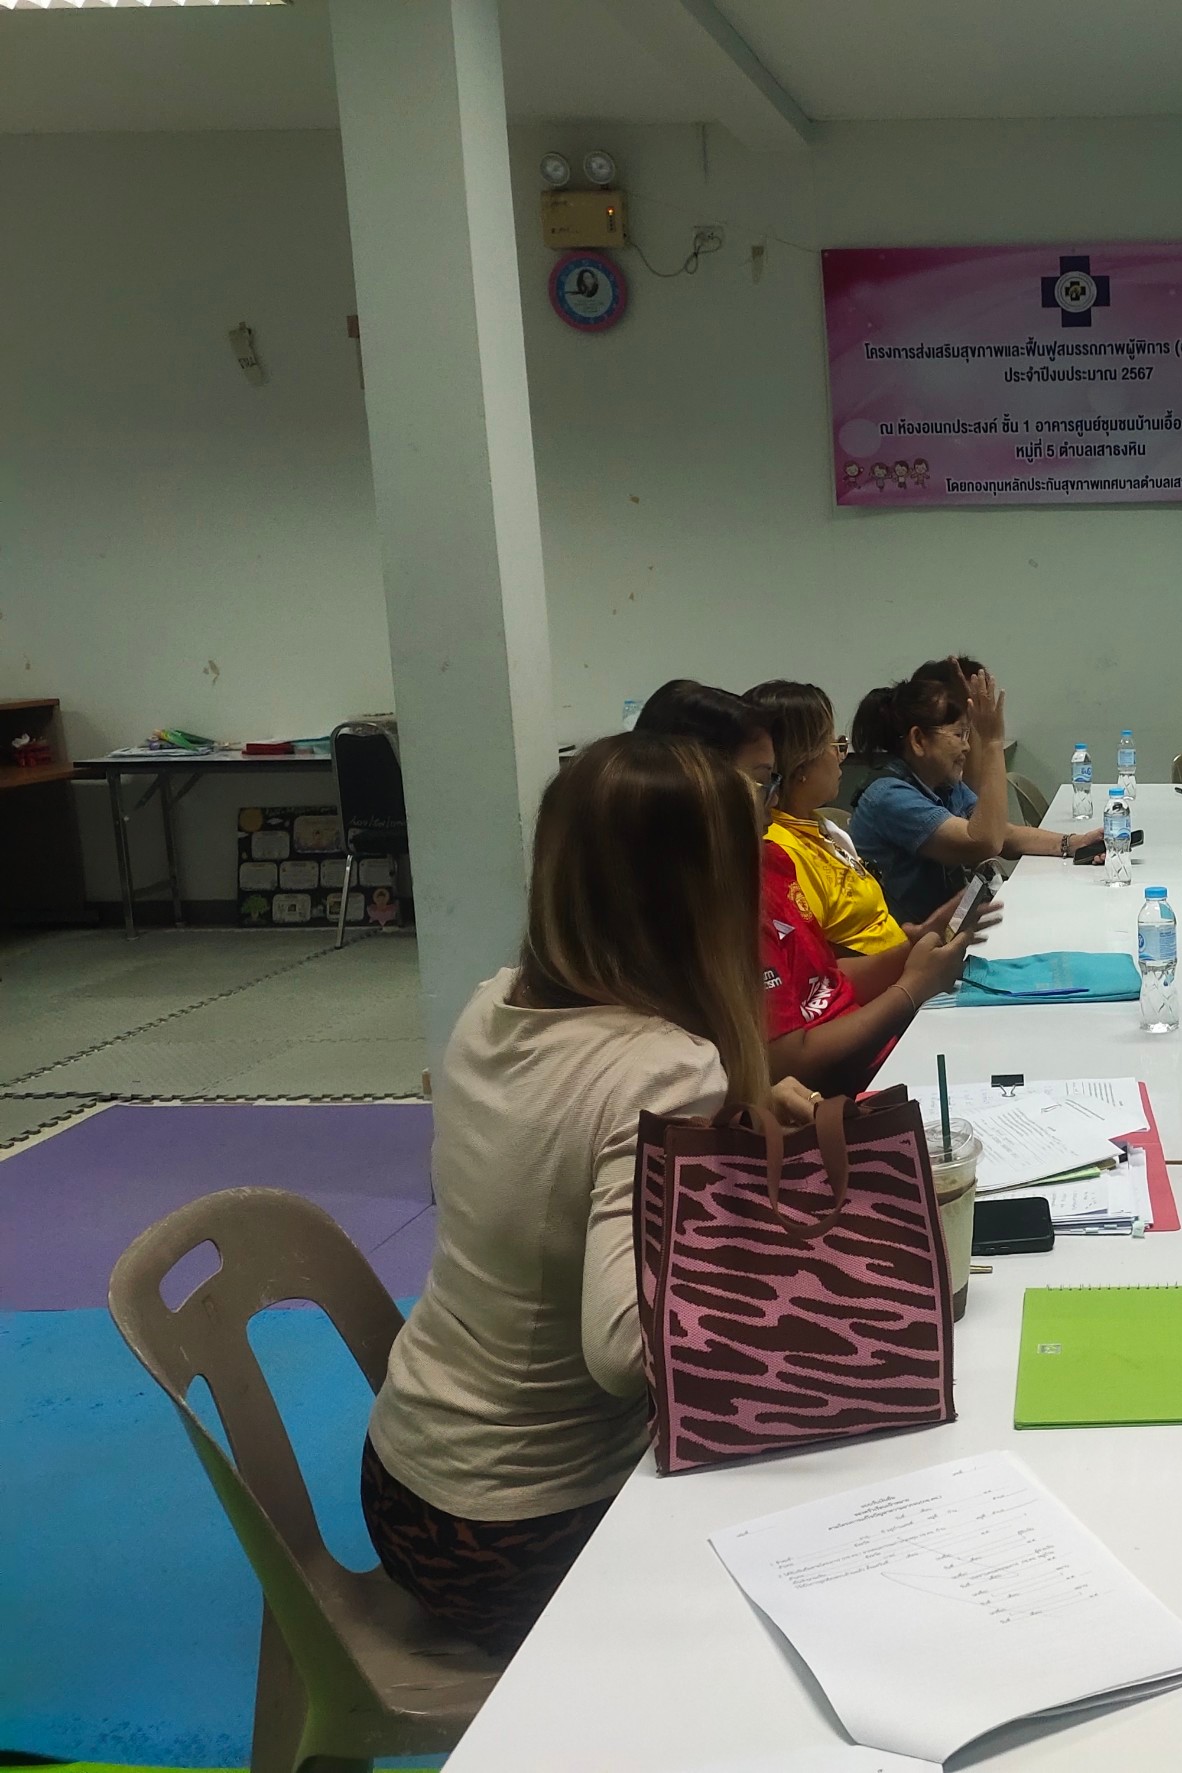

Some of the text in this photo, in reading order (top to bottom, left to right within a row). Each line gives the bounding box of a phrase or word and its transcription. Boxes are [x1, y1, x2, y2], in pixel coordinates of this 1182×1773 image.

[864, 337, 1170, 363] โครงการส่งเสริมสุขภาพและฟื้นฟูสมรรถภาพผู้พิการ
[1004, 366, 1154, 383] ประจำปีงบประมาณ 2567
[879, 421, 894, 435] ณ
[898, 418, 998, 435] ห้องอเนกประสงค์
[1001, 413, 1019, 433] ชั้น
[1023, 419, 1030, 433] 1
[1015, 438, 1146, 463] หมู่ที่ 5 ตำบลเสาธงหิน
